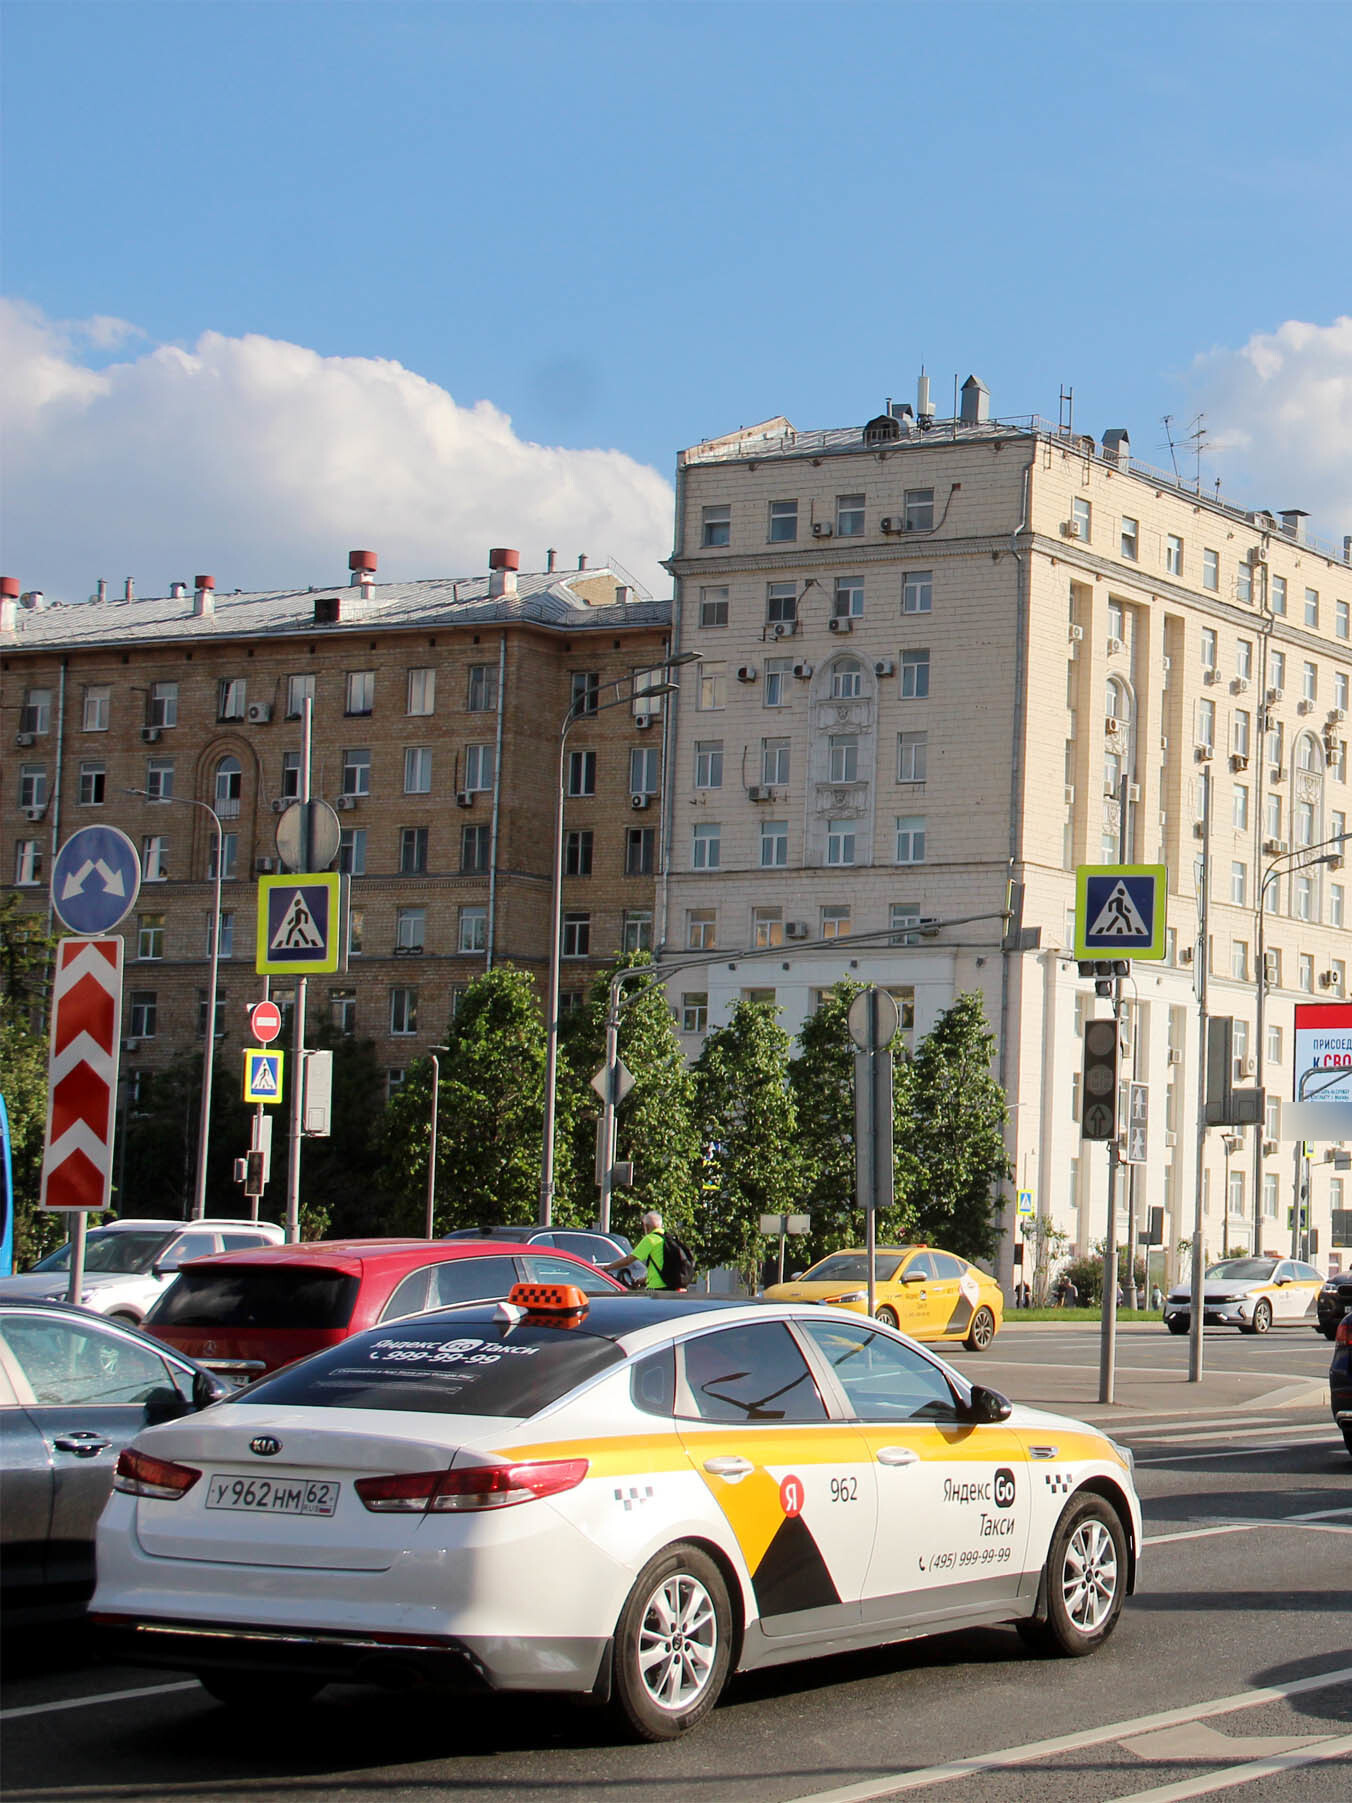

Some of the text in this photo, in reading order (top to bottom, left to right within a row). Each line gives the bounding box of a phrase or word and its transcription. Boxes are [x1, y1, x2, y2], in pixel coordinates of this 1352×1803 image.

[370, 1338, 441, 1350] Яндекс
[479, 1342, 541, 1355] Такси
[382, 1351, 500, 1364] 999-99-99
[253, 1439, 277, 1451] KIA
[216, 1480, 330, 1509] У962НМ 62
[784, 1483, 798, 1511] Я
[830, 1477, 857, 1502] 962
[944, 1474, 1014, 1504] Яндекс Go
[979, 1513, 1015, 1537] Такси
[929, 1548, 1011, 1572] (495) 999-99-99
